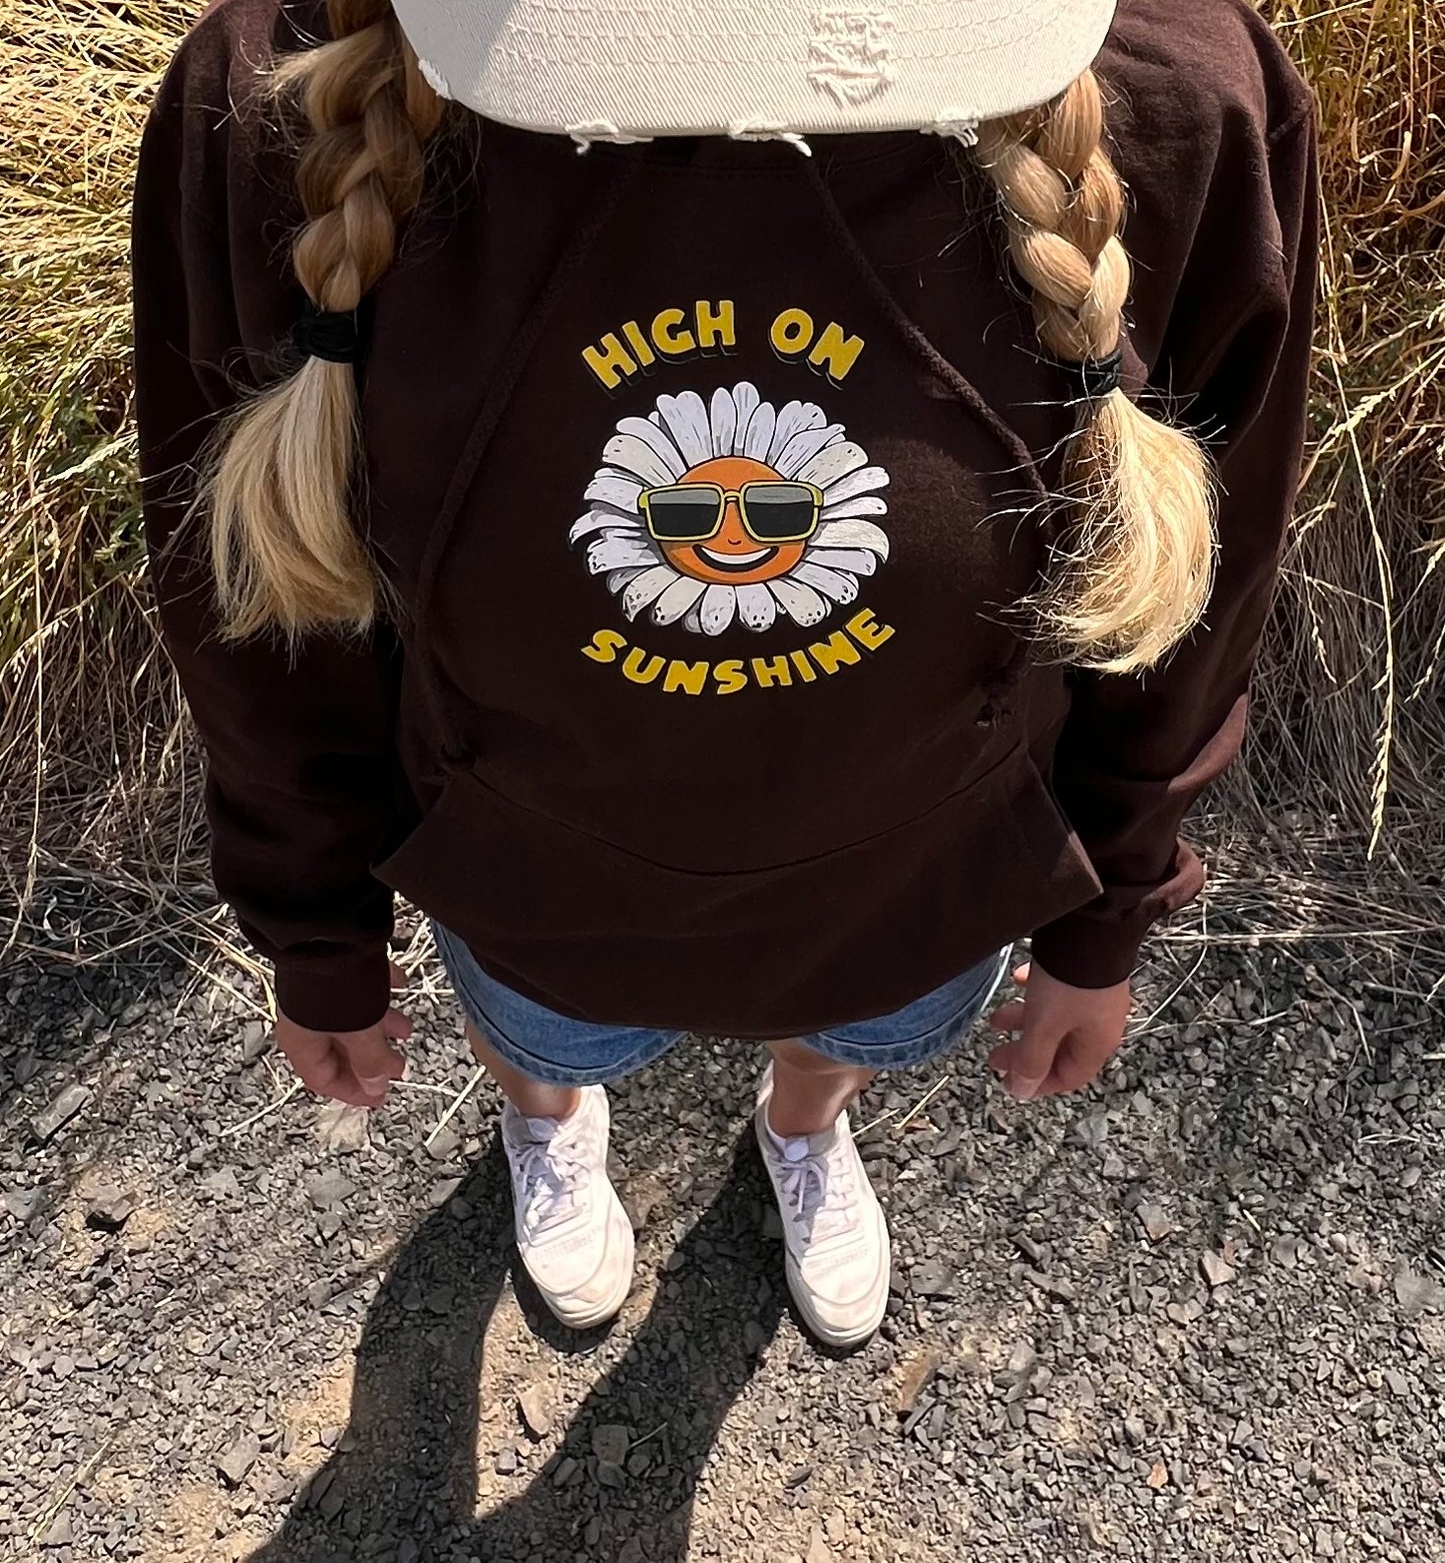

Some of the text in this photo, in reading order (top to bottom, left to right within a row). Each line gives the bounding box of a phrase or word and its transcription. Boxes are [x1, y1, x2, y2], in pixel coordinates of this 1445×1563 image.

[580, 299, 866, 392] HIGH ON
[580, 606, 896, 696] SUNSHINE
